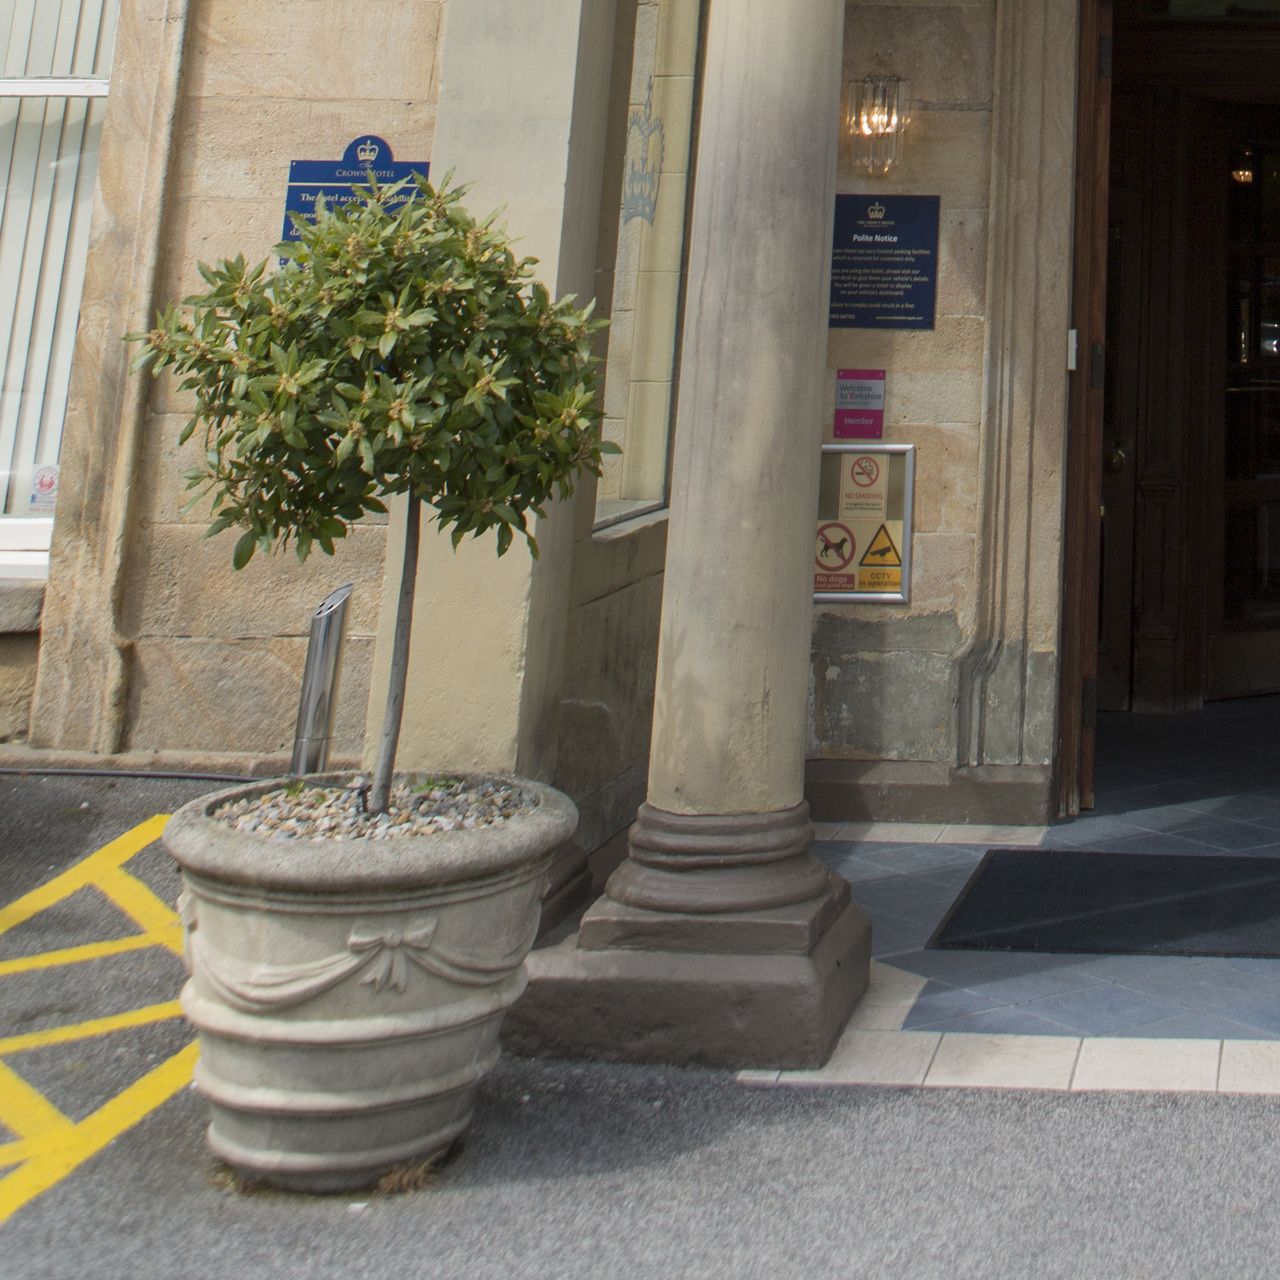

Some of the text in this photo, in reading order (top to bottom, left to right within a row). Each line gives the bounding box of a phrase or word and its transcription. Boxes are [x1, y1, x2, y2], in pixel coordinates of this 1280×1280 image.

[300, 193, 315, 201] The
[852, 234, 898, 243] Polite Notice
[839, 384, 873, 392] Welcome
[840, 392, 882, 400] to Yorkshire
[844, 416, 874, 425] Member
[828, 575, 848, 584] dogs
[870, 572, 892, 580] CCTV
